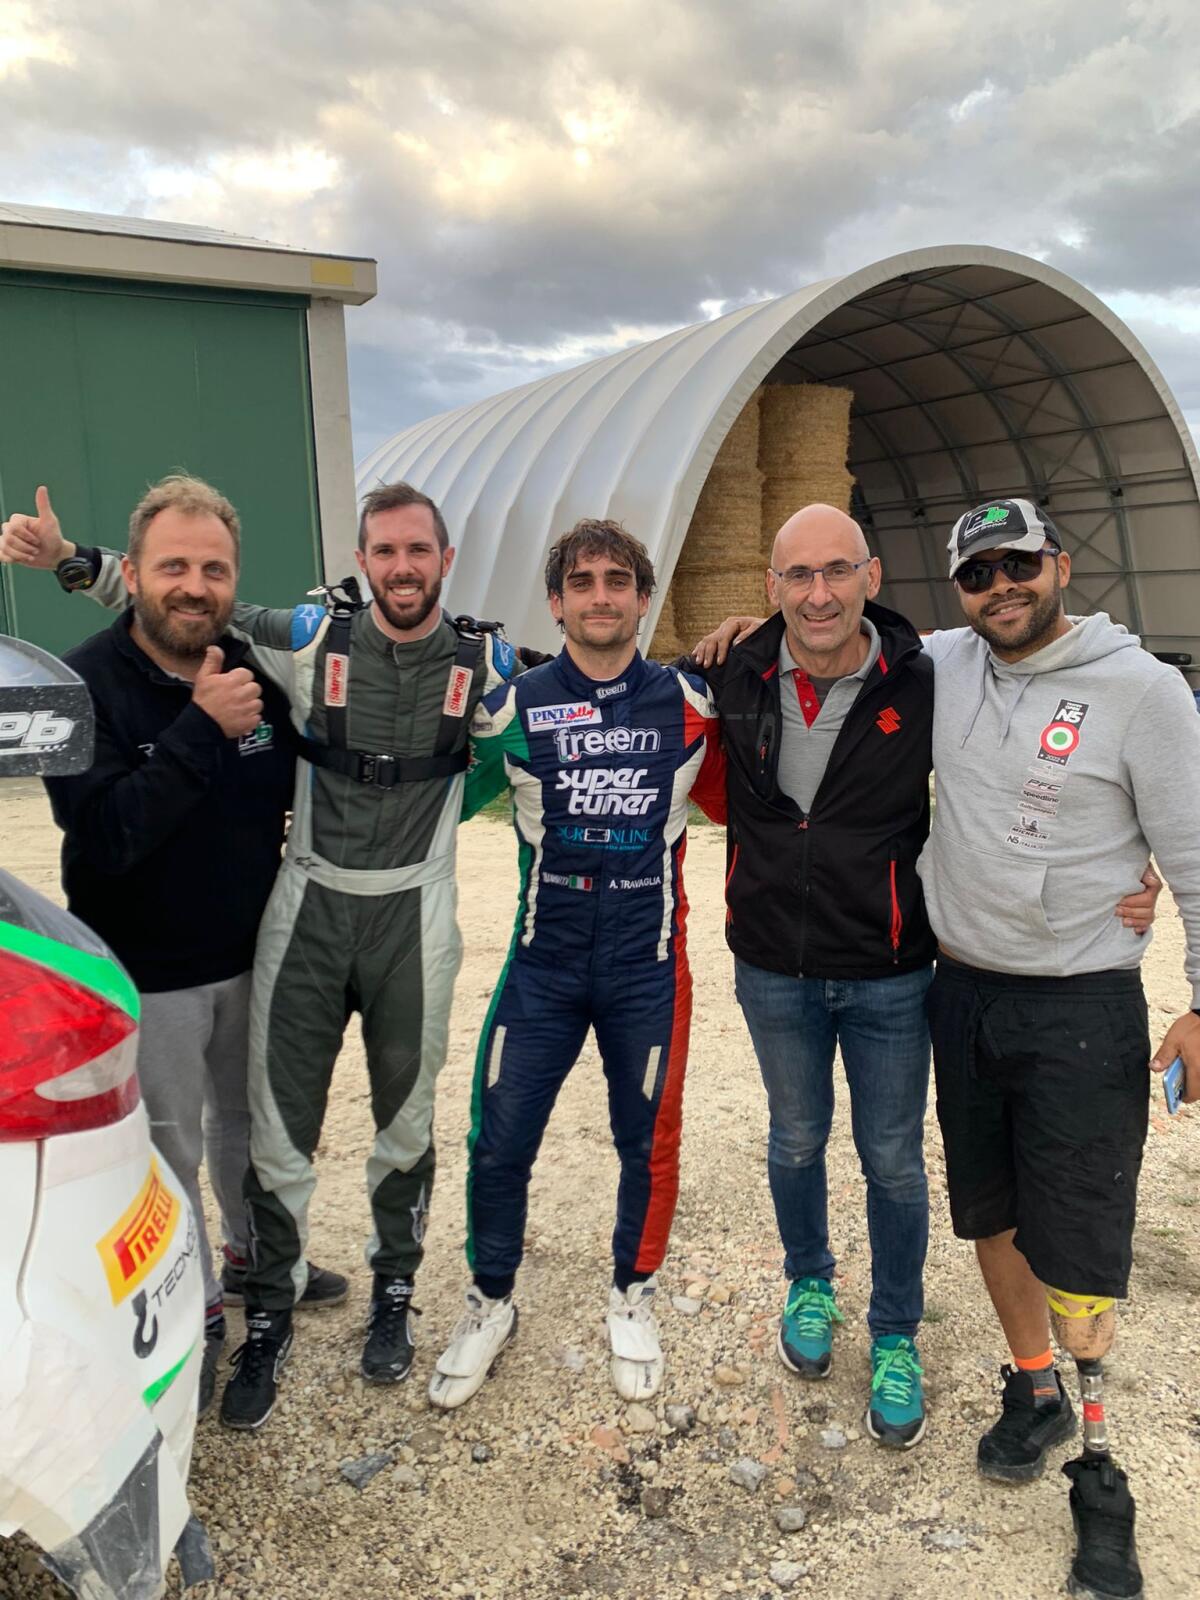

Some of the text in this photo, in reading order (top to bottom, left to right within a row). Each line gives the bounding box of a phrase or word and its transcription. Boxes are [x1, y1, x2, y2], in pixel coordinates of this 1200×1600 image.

[331, 658, 342, 704] SIMPSON
[449, 671, 466, 712] SIMPSON
[1012, 827, 1047, 839] MICHELIN
[609, 876, 661, 889] A. TRAVAGLIA
[113, 1173, 173, 1280] PIRELLI
